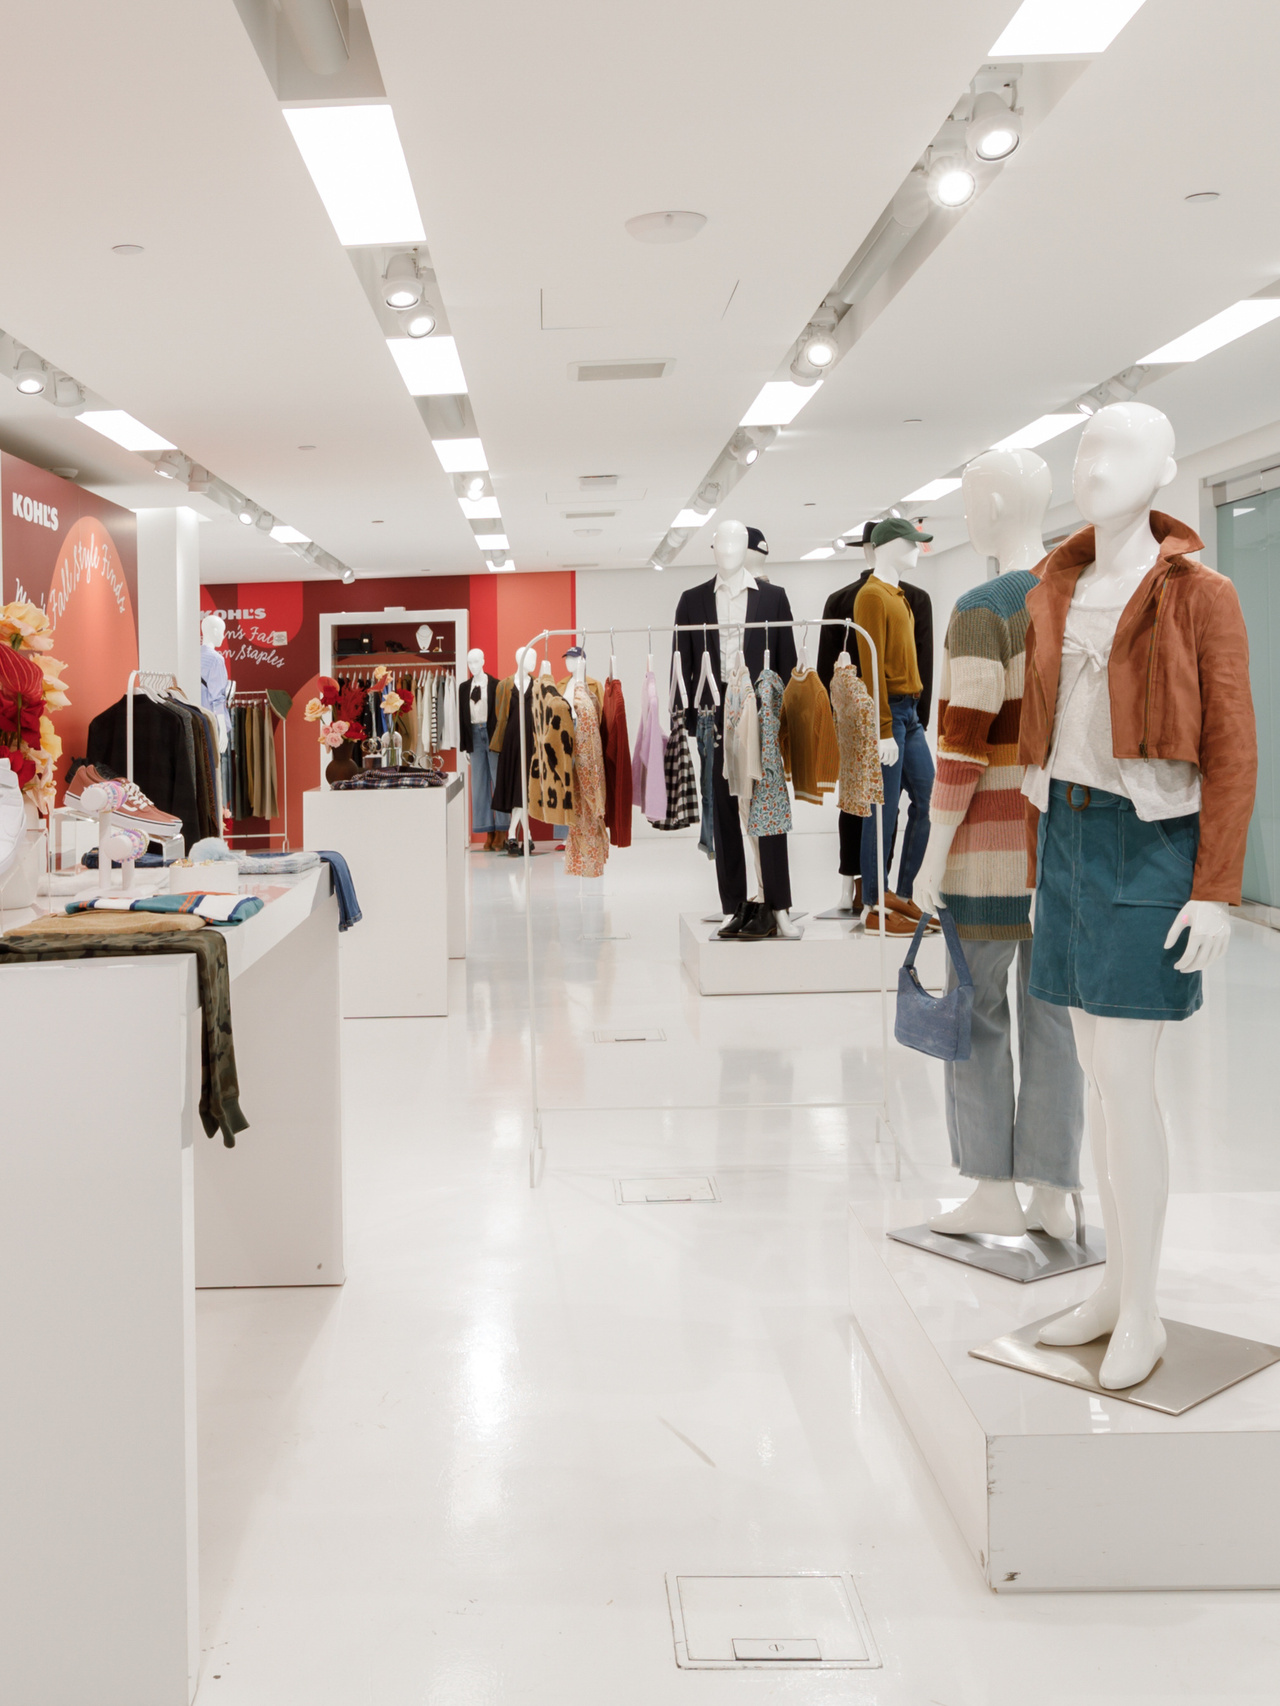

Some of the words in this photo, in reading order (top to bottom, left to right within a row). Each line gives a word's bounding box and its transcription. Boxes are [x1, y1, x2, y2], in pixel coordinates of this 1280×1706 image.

[12, 492, 59, 531] KOHL'S
[49, 558, 73, 631] Fall
[73, 532, 100, 591] Style
[101, 543, 126, 613] Finds
[248, 626, 276, 644] Fal
[234, 643, 286, 669] Staples
